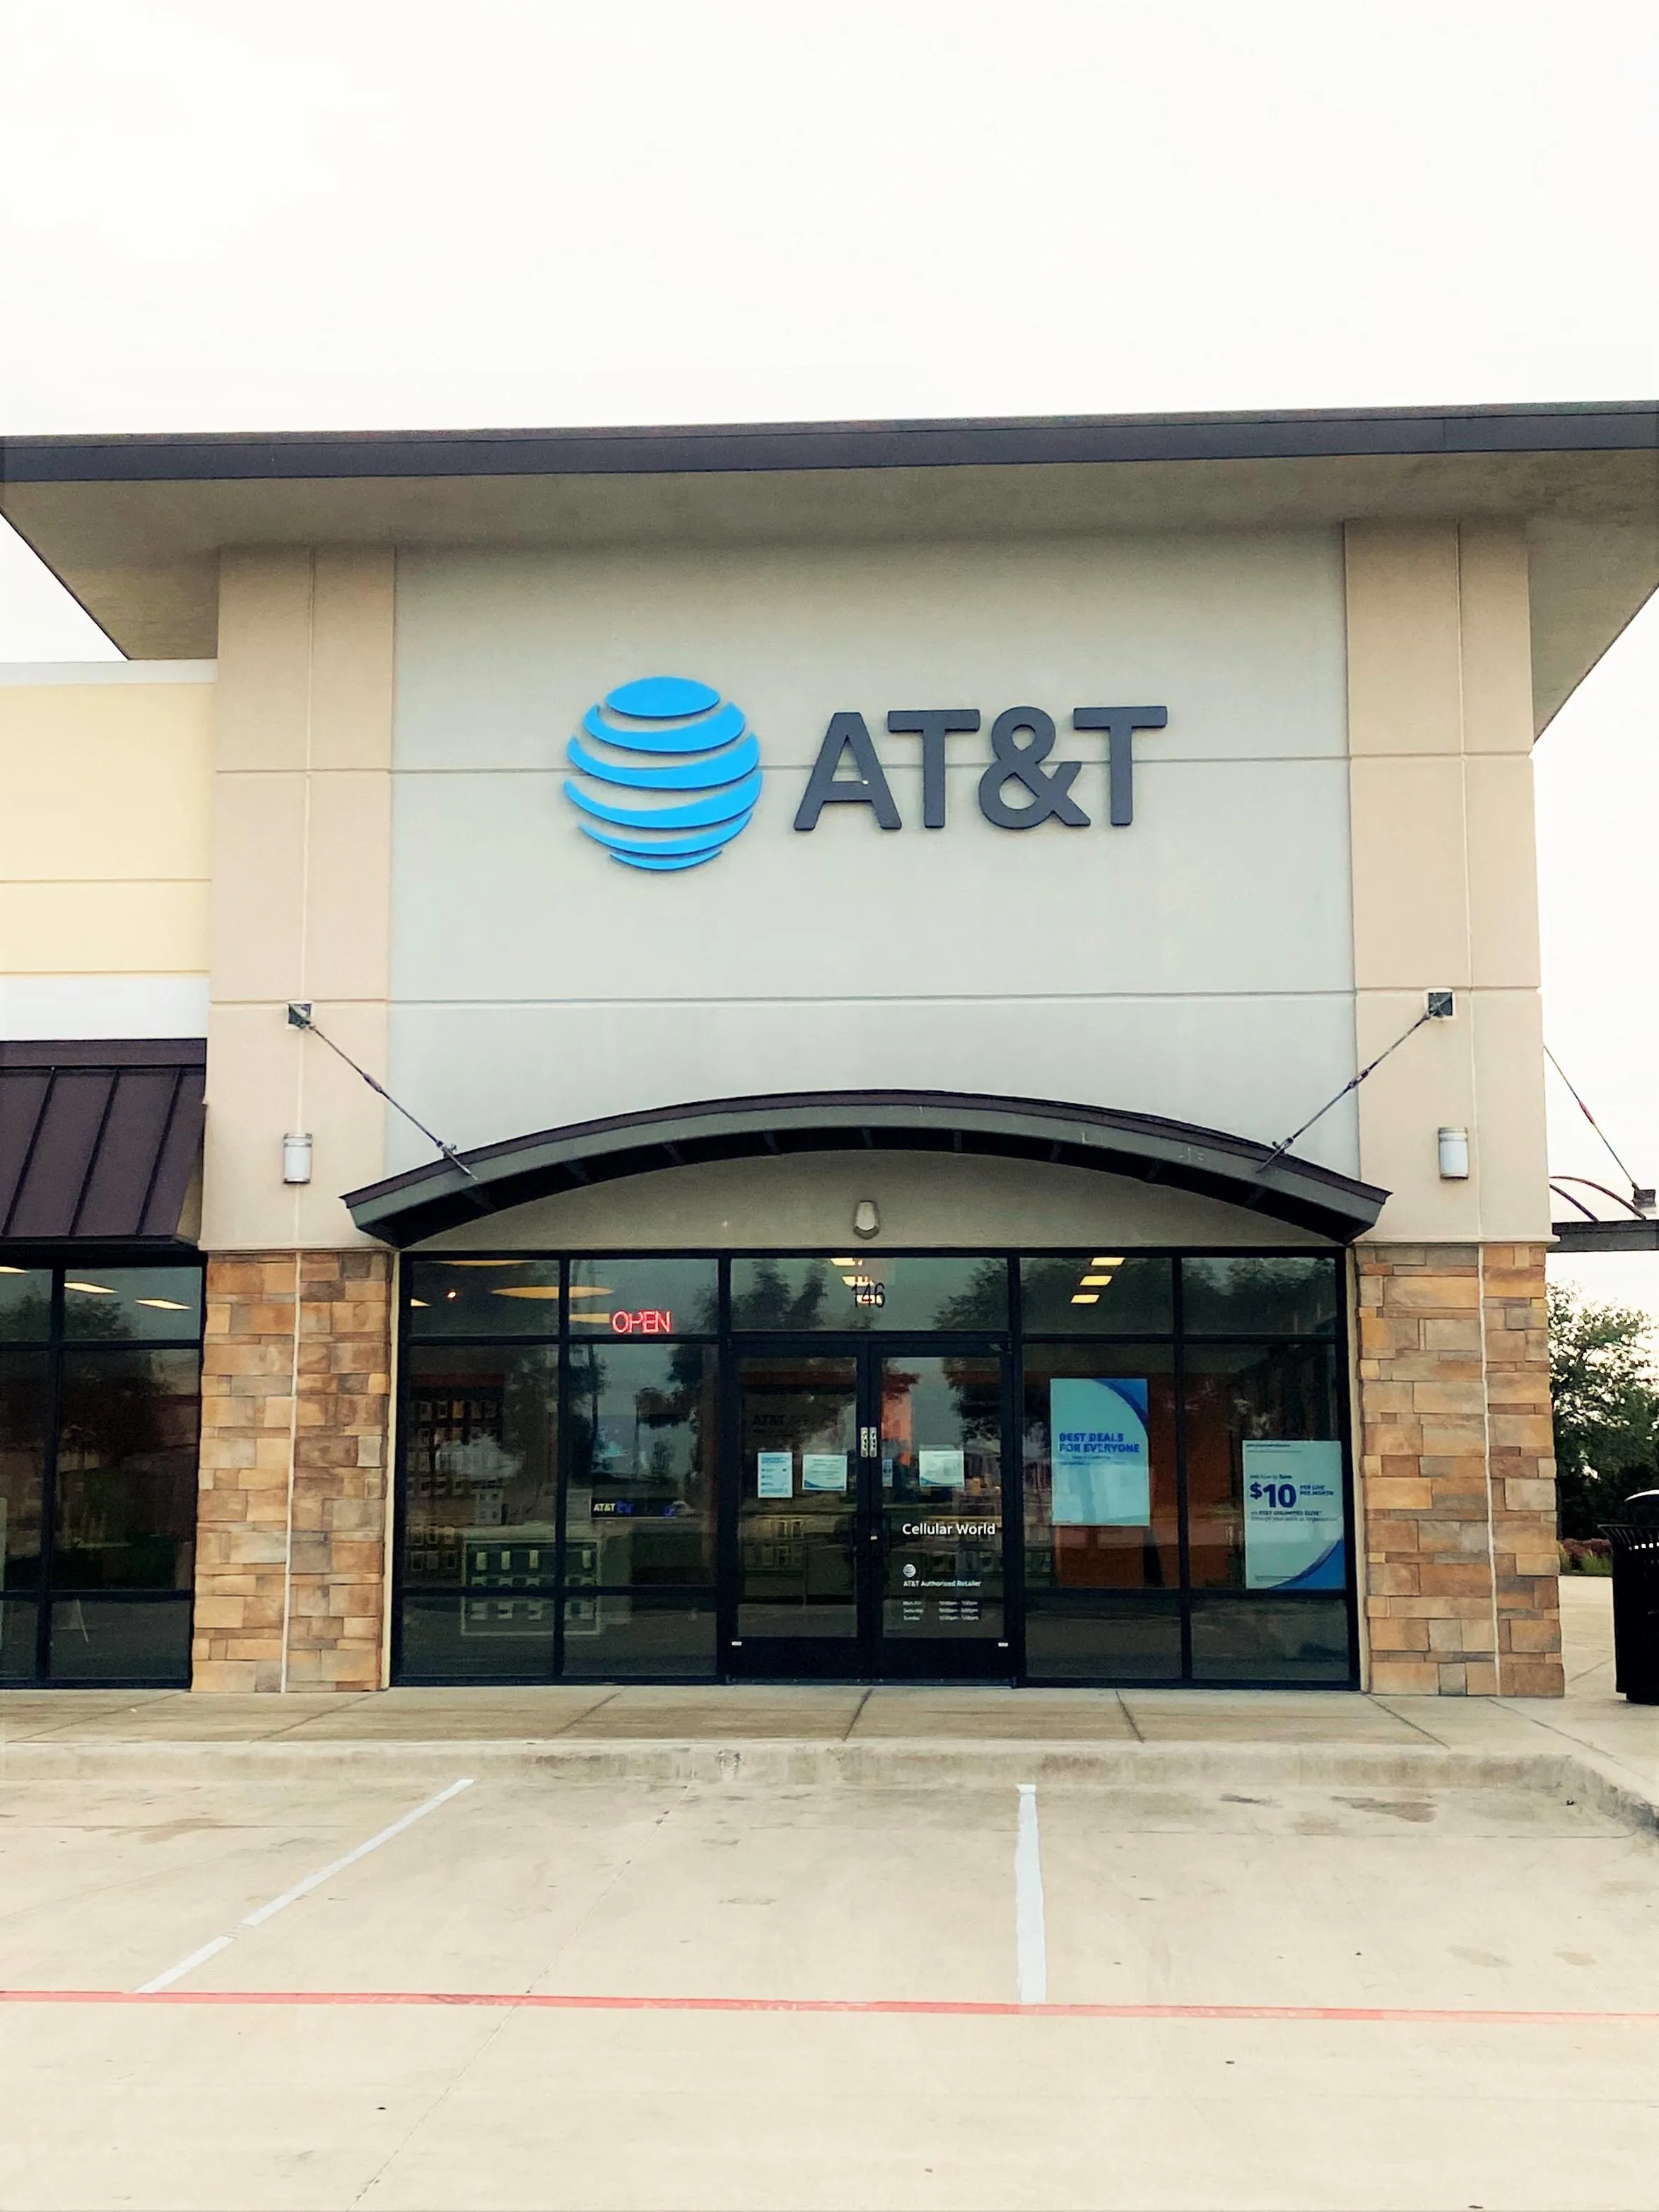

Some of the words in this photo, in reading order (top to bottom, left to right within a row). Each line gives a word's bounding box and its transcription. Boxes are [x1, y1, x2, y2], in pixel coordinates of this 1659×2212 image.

[794, 706, 1168, 831] AT&T
[851, 1282, 886, 1308] 146
[611, 1309, 672, 1335] OPEN
[1059, 1432, 1086, 1442] BEST
[1089, 1432, 1125, 1442] DEALS
[1059, 1444, 1081, 1453] FOR
[1083, 1444, 1140, 1453] EVERYONE
[1249, 1482, 1297, 1508] $10
[593, 1503, 615, 1512] AT&T
[902, 1522, 954, 1535] Cellular
[956, 1522, 996, 1535] World
